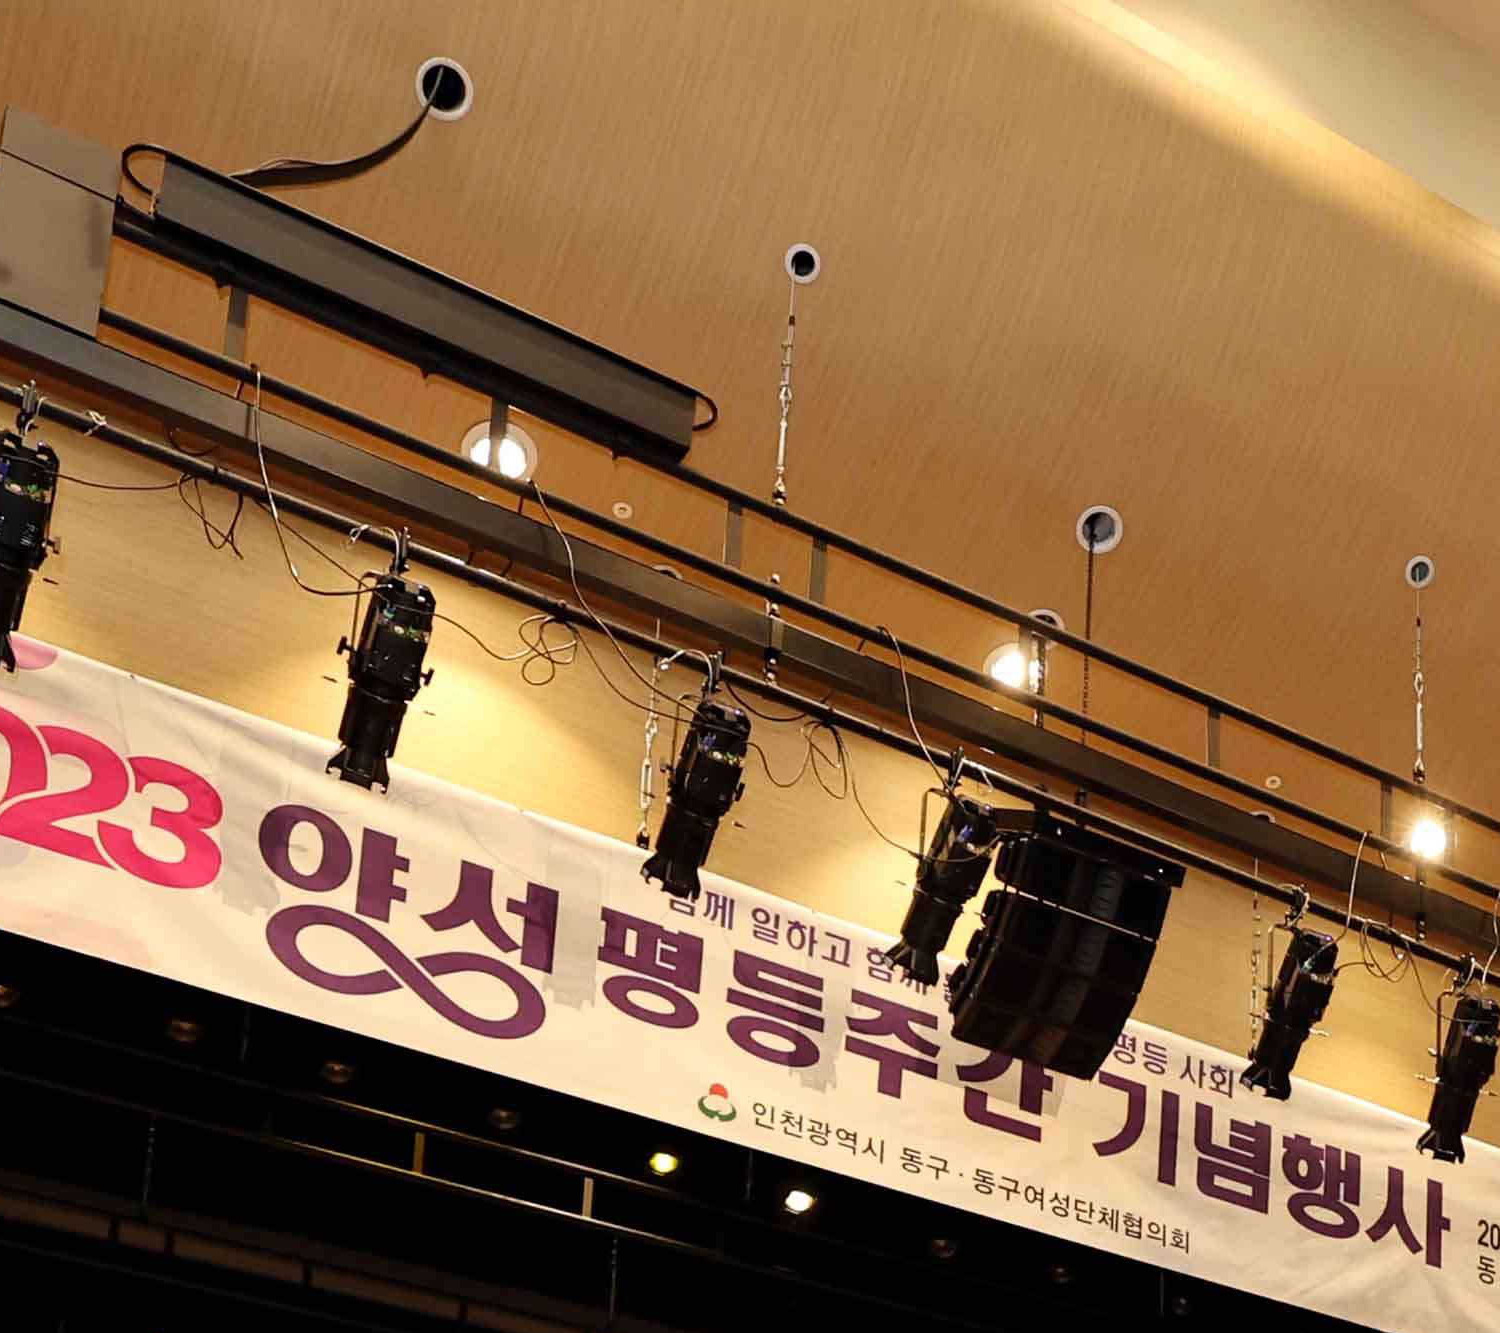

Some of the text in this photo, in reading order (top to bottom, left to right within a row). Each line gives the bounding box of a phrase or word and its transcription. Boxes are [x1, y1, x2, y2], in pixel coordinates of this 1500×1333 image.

[751, 905, 852, 967] 일하고
[257, 803, 560, 1041] 양성
[596, 905, 1054, 1145] 평등주간
[1092, 1071, 1451, 1269] 기념행사
[1180, 1059, 1236, 1098] 사회
[750, 1101, 1192, 1256] 인천광역시 동구 동구여성단체협의회
